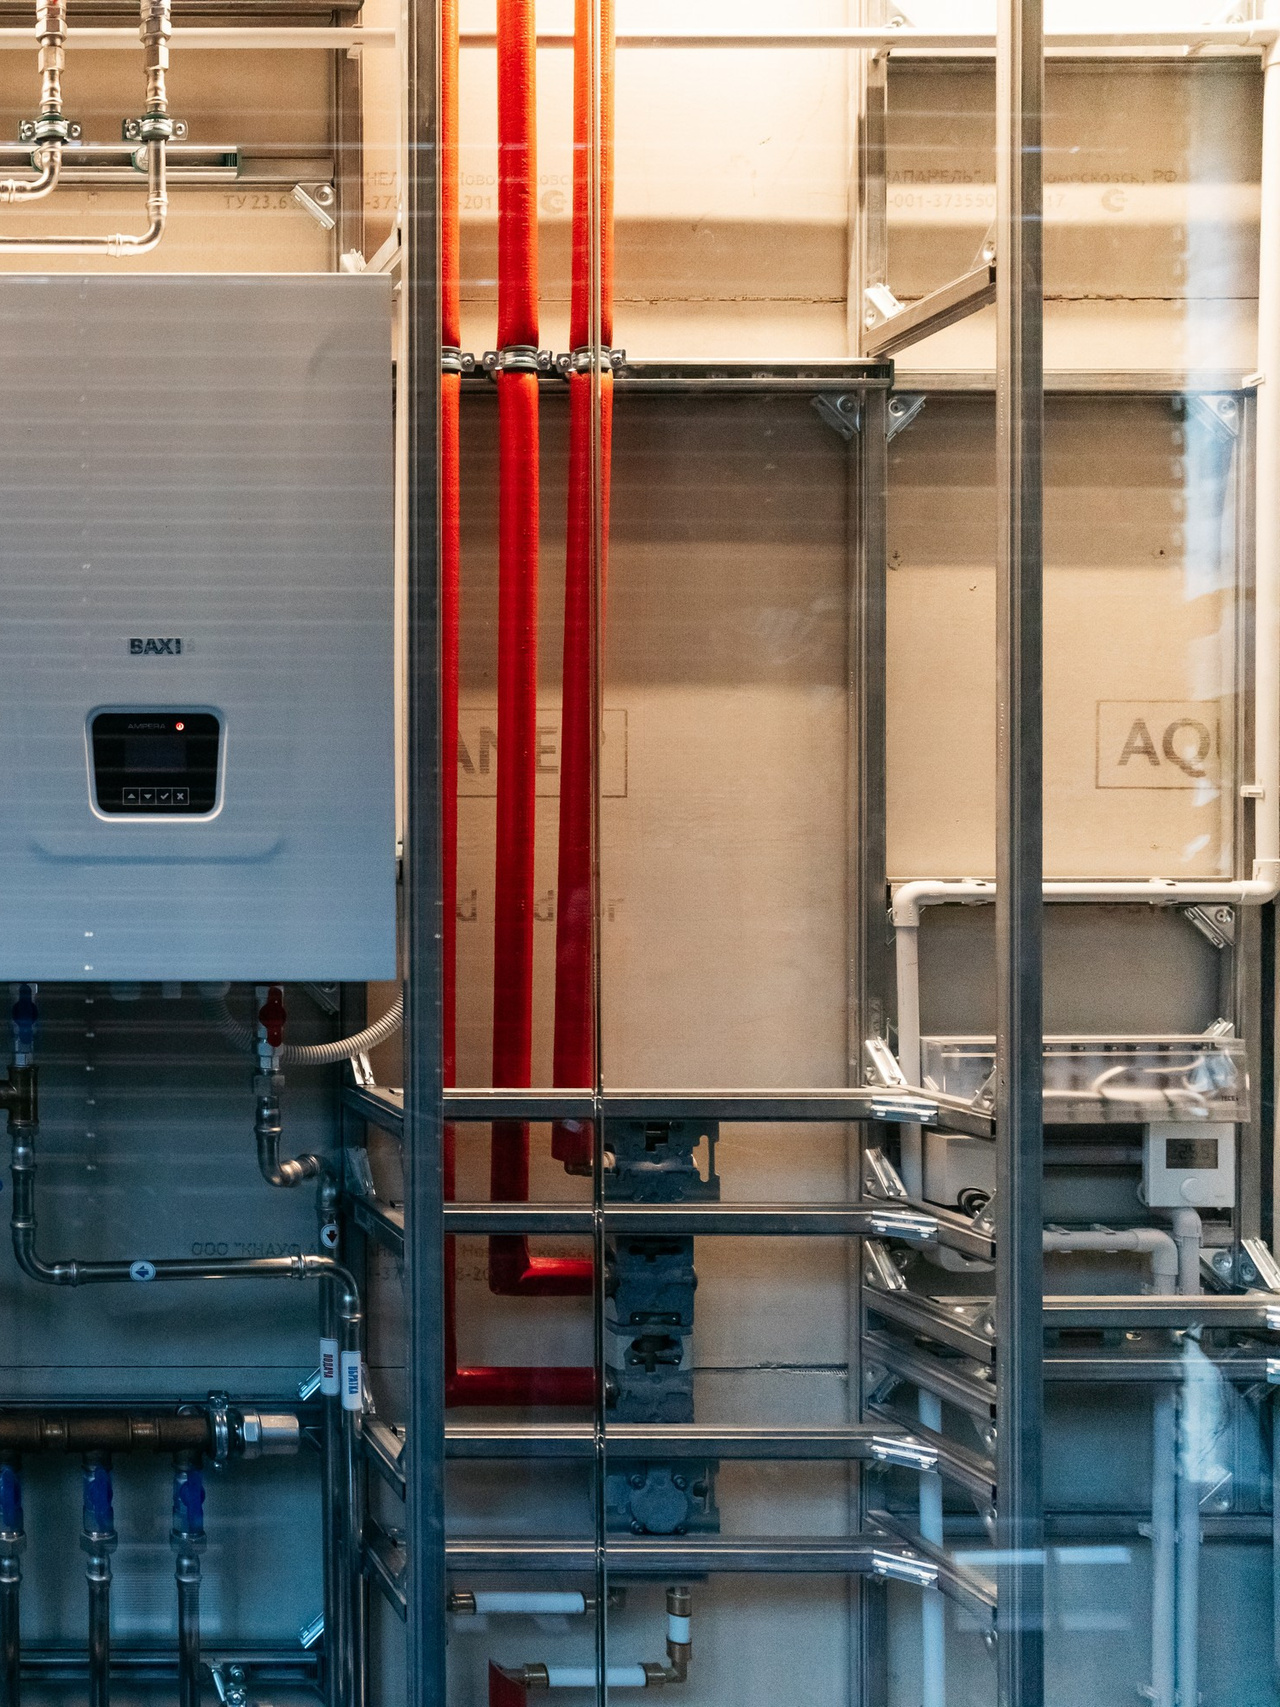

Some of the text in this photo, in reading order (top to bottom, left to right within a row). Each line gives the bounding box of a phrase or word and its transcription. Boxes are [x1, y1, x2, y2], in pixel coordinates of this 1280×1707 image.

[129, 637, 183, 656] BAXI
[127, 722, 166, 730] AMPERA
[1117, 717, 1221, 778] AQ
[191, 1241, 229, 1256] ООО
[322, 1353, 334, 1379] ПОДАЧА
[347, 1366, 359, 1395] ОБРАТКА
